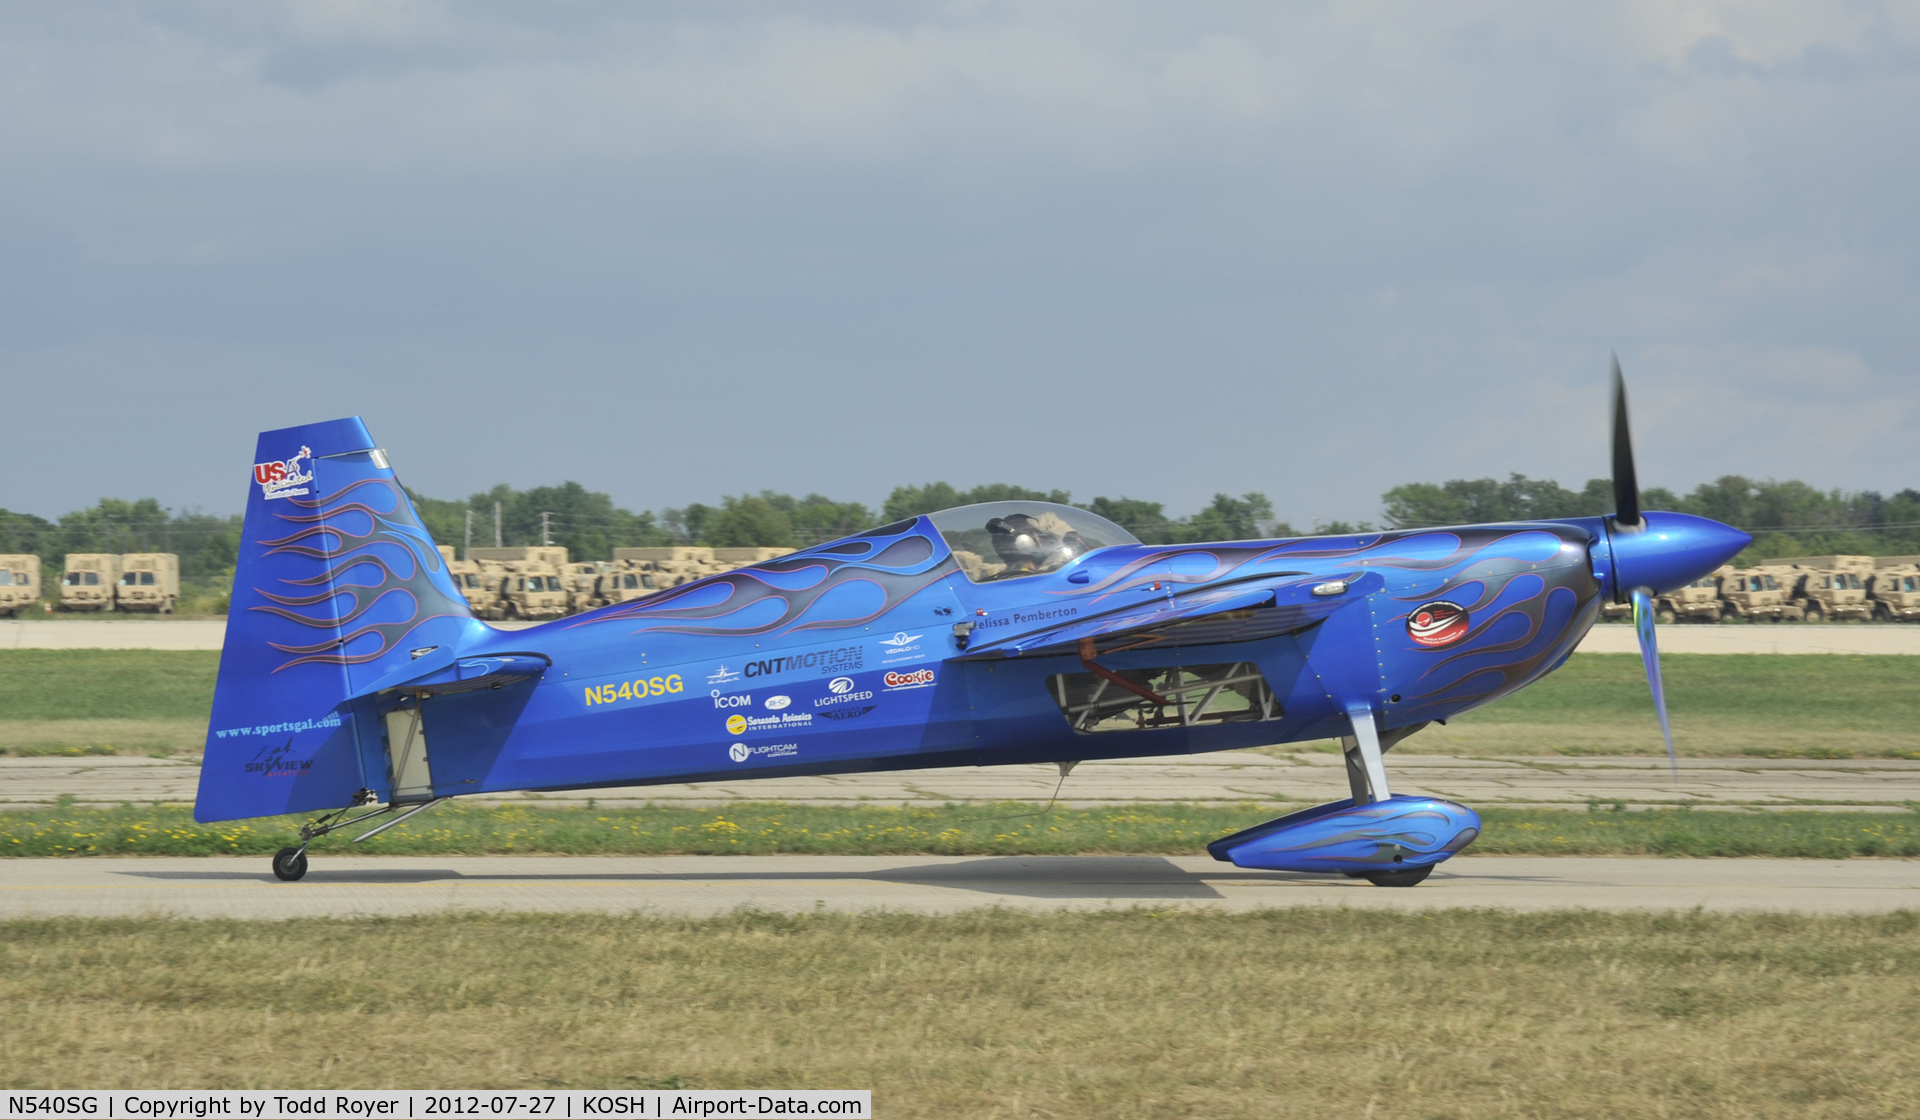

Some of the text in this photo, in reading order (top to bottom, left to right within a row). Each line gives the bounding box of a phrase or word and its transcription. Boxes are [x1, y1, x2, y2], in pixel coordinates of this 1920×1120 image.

[974, 607, 1078, 630] elissa Pemberton
[821, 661, 863, 675] SYSTEMS
[884, 669, 934, 687] Cookie
[585, 674, 684, 706] N540SG
[814, 691, 873, 707] LIGHTSPEED
[747, 712, 812, 726] Sarasota Avionics
[748, 721, 813, 731] INTERNATIONAL
[216, 718, 342, 738] www.sportsgal.com
